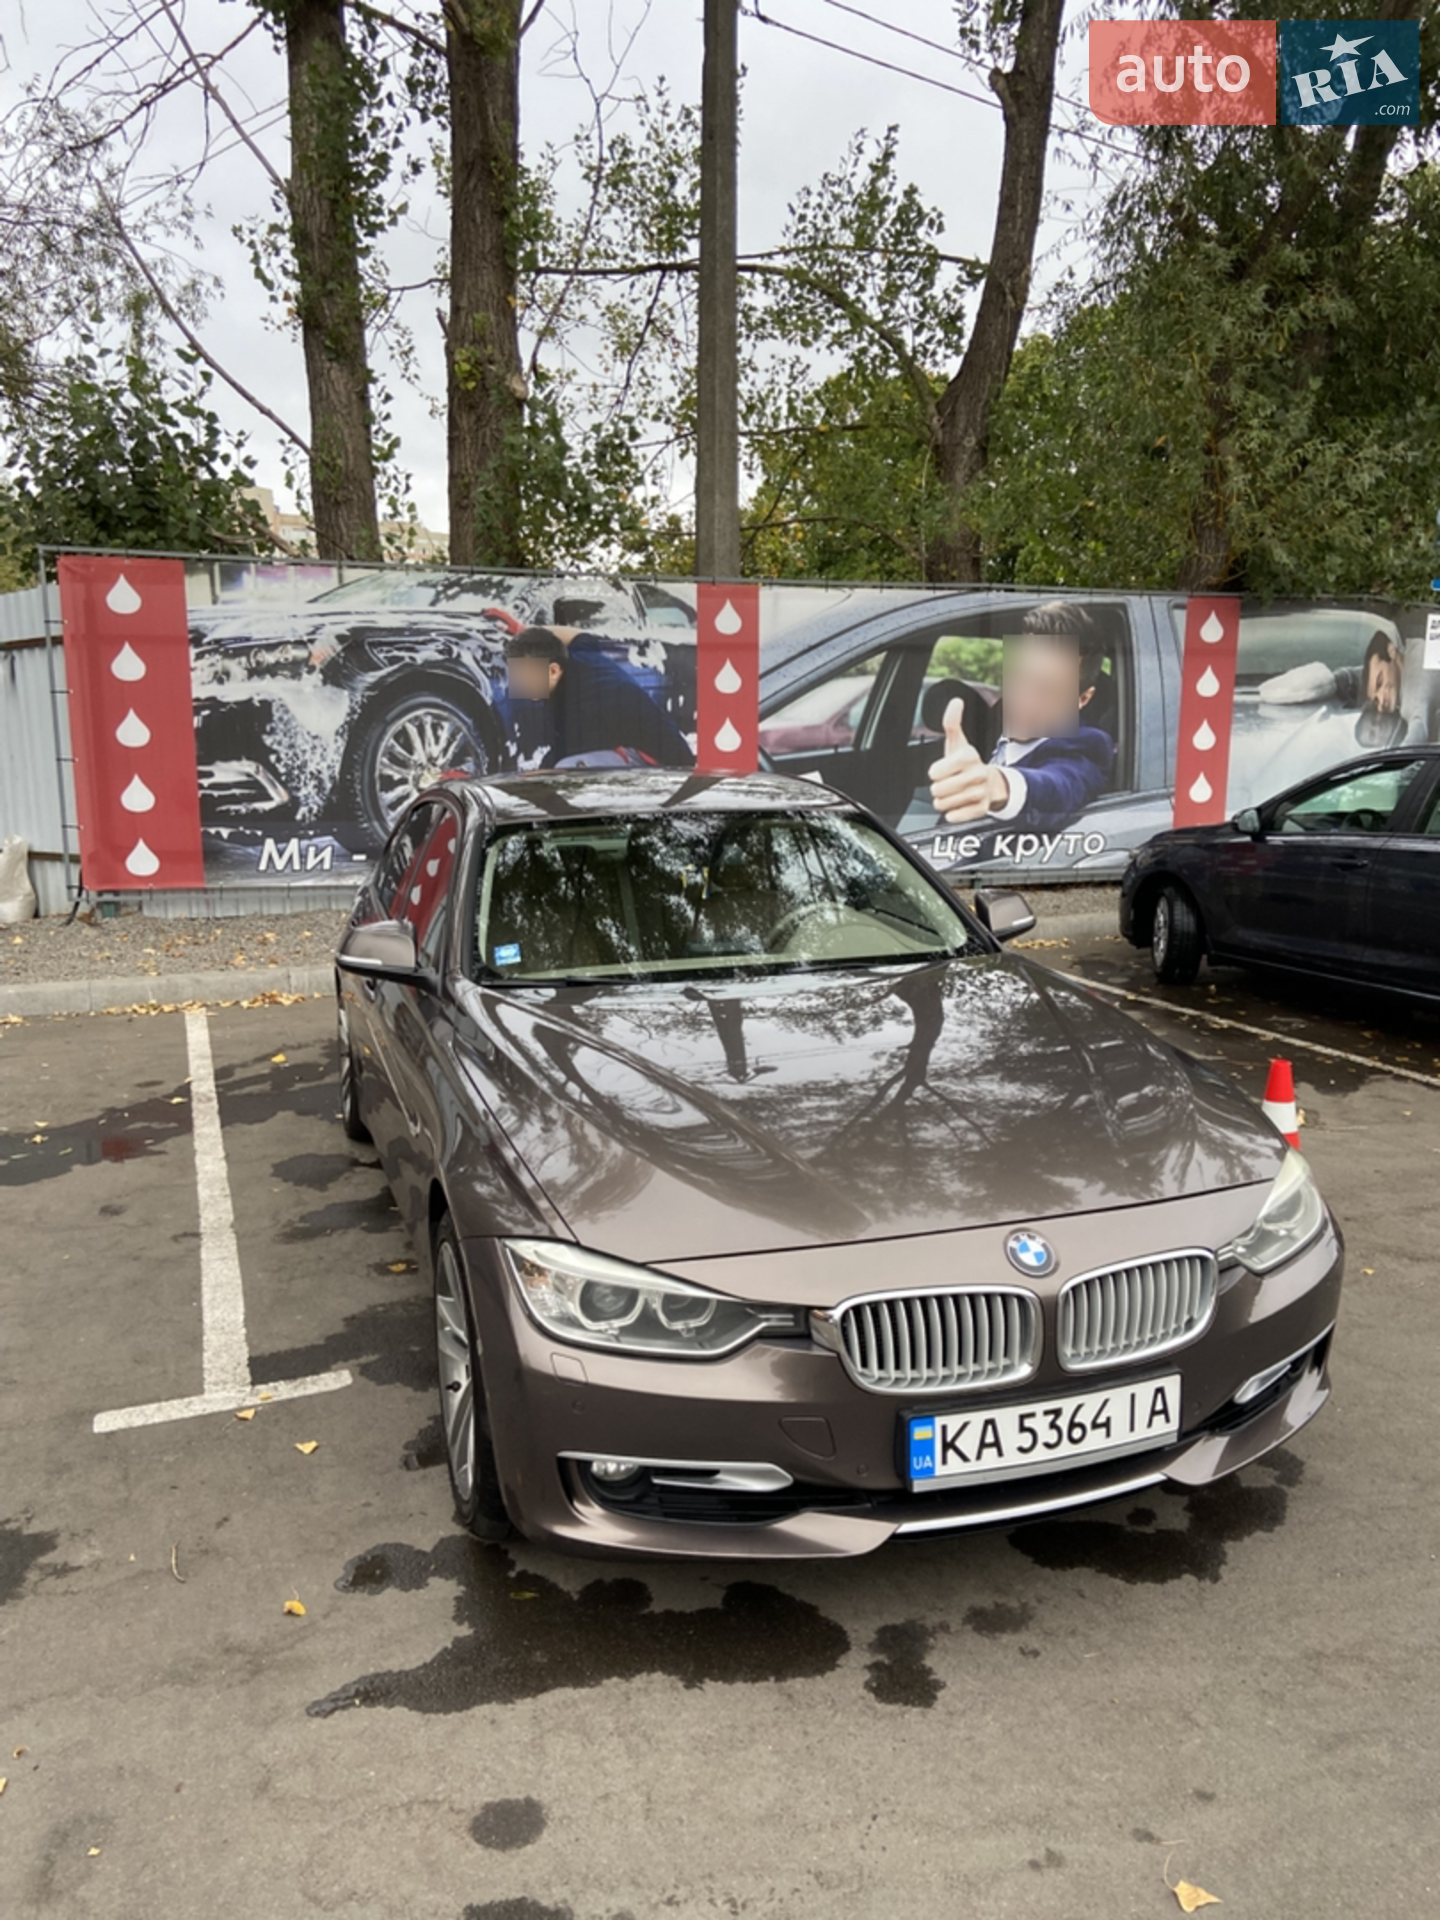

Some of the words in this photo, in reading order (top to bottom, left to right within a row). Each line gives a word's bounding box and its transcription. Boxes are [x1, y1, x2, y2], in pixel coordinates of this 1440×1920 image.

[258, 837, 333, 871] Ми
[932, 833, 981, 861] це
[993, 833, 1105, 863] круто
[940, 1417, 1004, 1466] KA
[1016, 1398, 1112, 1454] 5364
[1128, 1385, 1171, 1433] IA
[912, 1455, 933, 1470] UA
